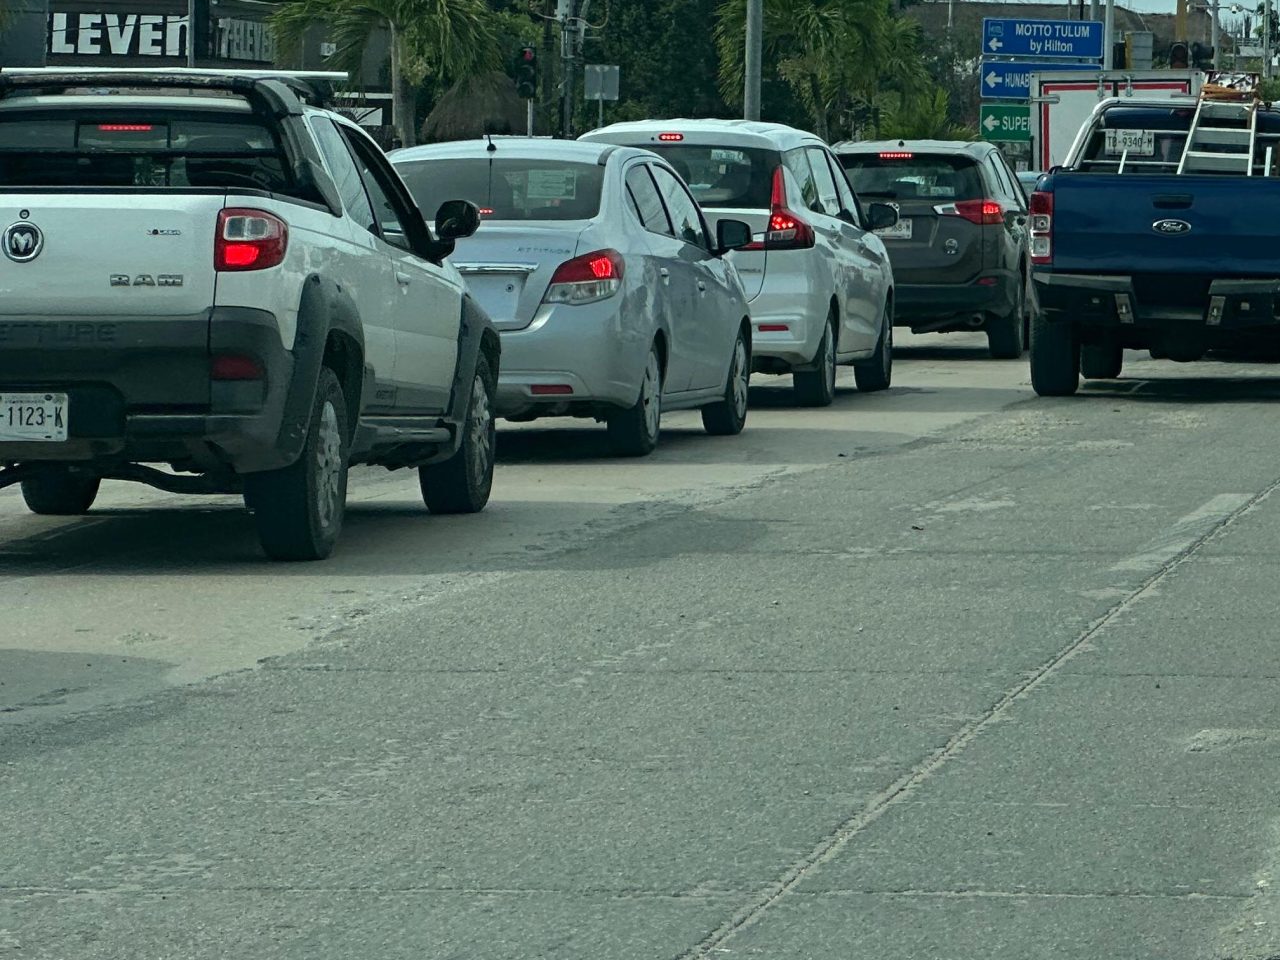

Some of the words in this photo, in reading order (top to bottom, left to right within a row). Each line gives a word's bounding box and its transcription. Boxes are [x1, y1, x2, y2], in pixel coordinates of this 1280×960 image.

[1015, 23, 1052, 37] MOTTO
[1054, 25, 1090, 38] TULUM
[1029, 38, 1042, 54] by
[1044, 40, 1073, 52] Hilton
[110, 274, 184, 287] RAM
